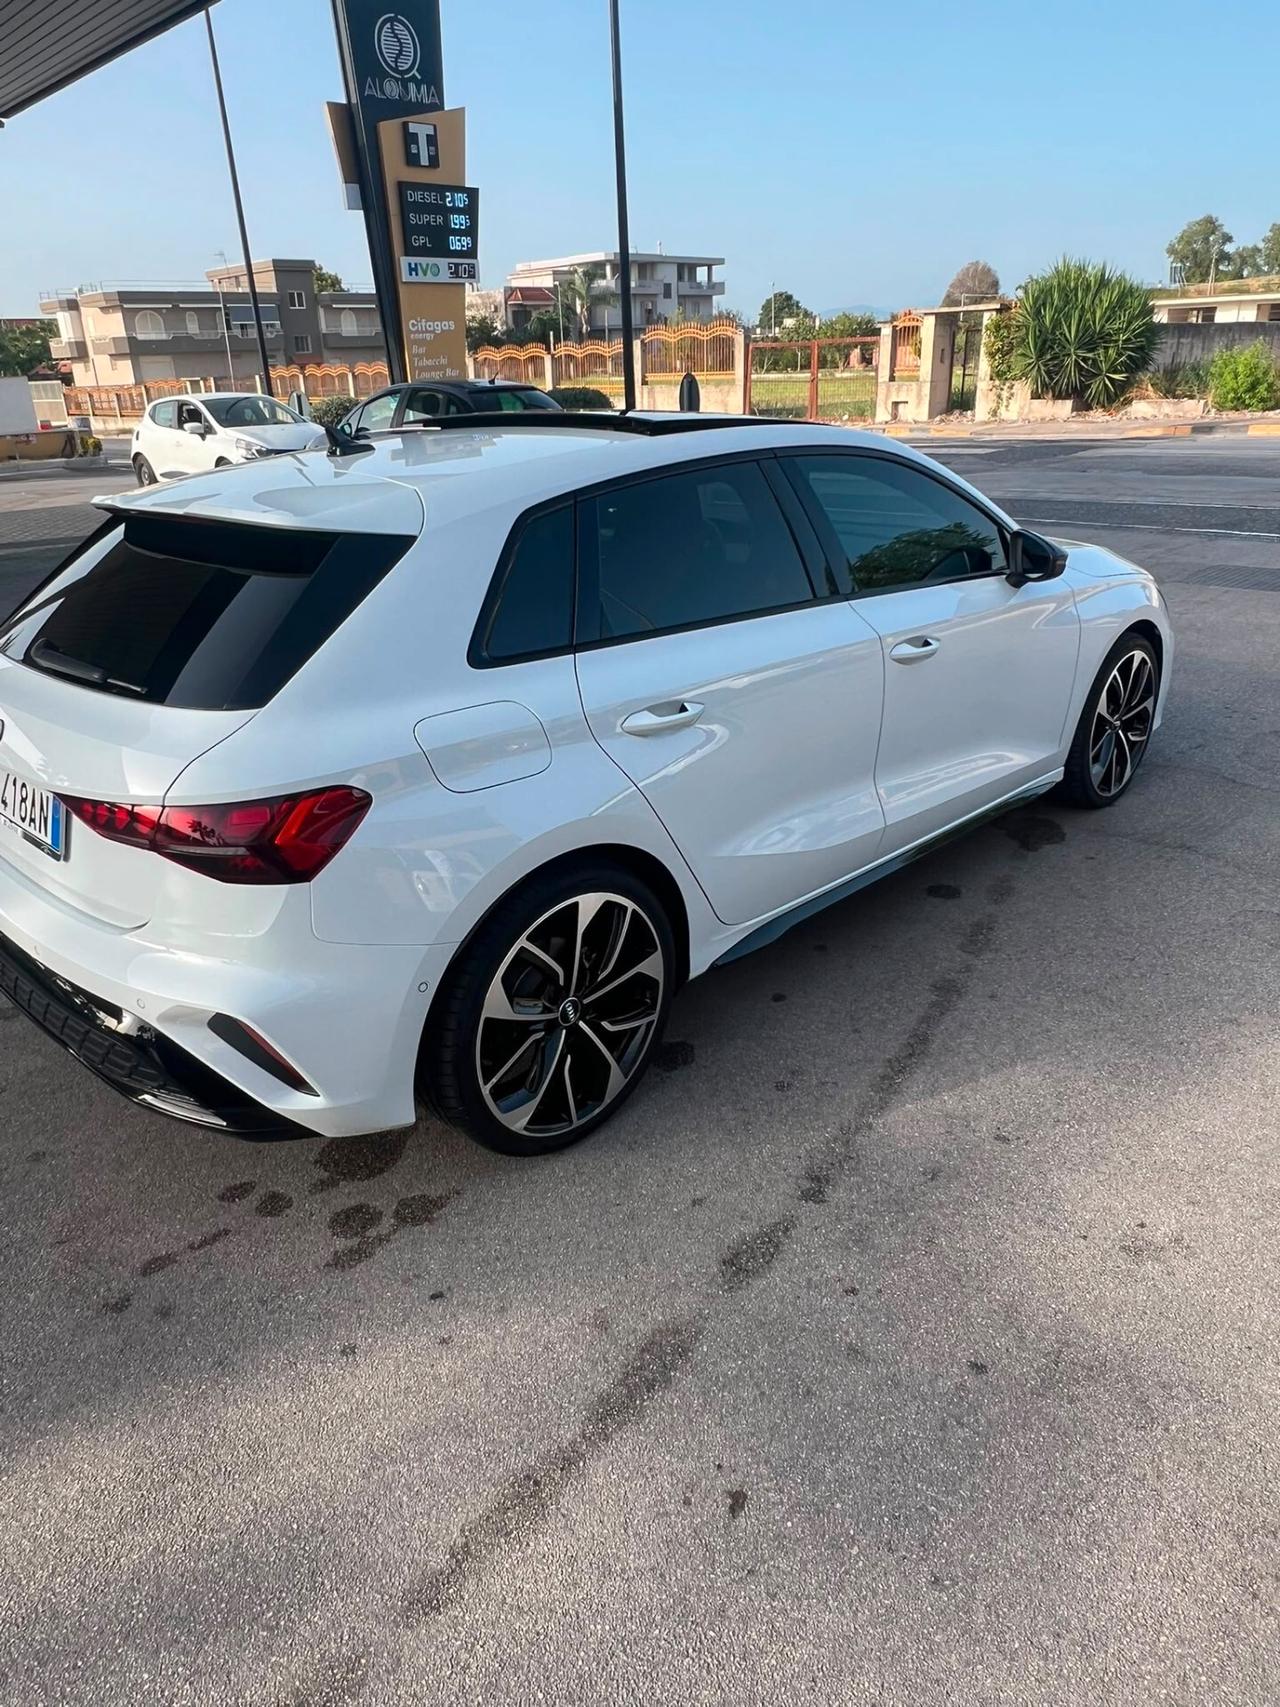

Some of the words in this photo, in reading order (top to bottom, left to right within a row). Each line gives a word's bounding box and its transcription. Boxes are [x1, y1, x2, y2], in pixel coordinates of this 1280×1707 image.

[364, 77, 441, 105] ALQUIMIA
[408, 123, 435, 166] T
[407, 190, 443, 204] DIESEL
[409, 213, 444, 226] SUPER
[411, 235, 432, 247] GPL
[408, 262, 440, 277] HVO
[408, 317, 455, 333] Cifagas
[410, 333, 435, 341] energy
[412, 345, 427, 354] Bar
[413, 355, 448, 367] Tabacchi
[415, 369, 445, 379] Lounge
[446, 368, 460, 377] Bar
[1, 773, 50, 837] 418AN
